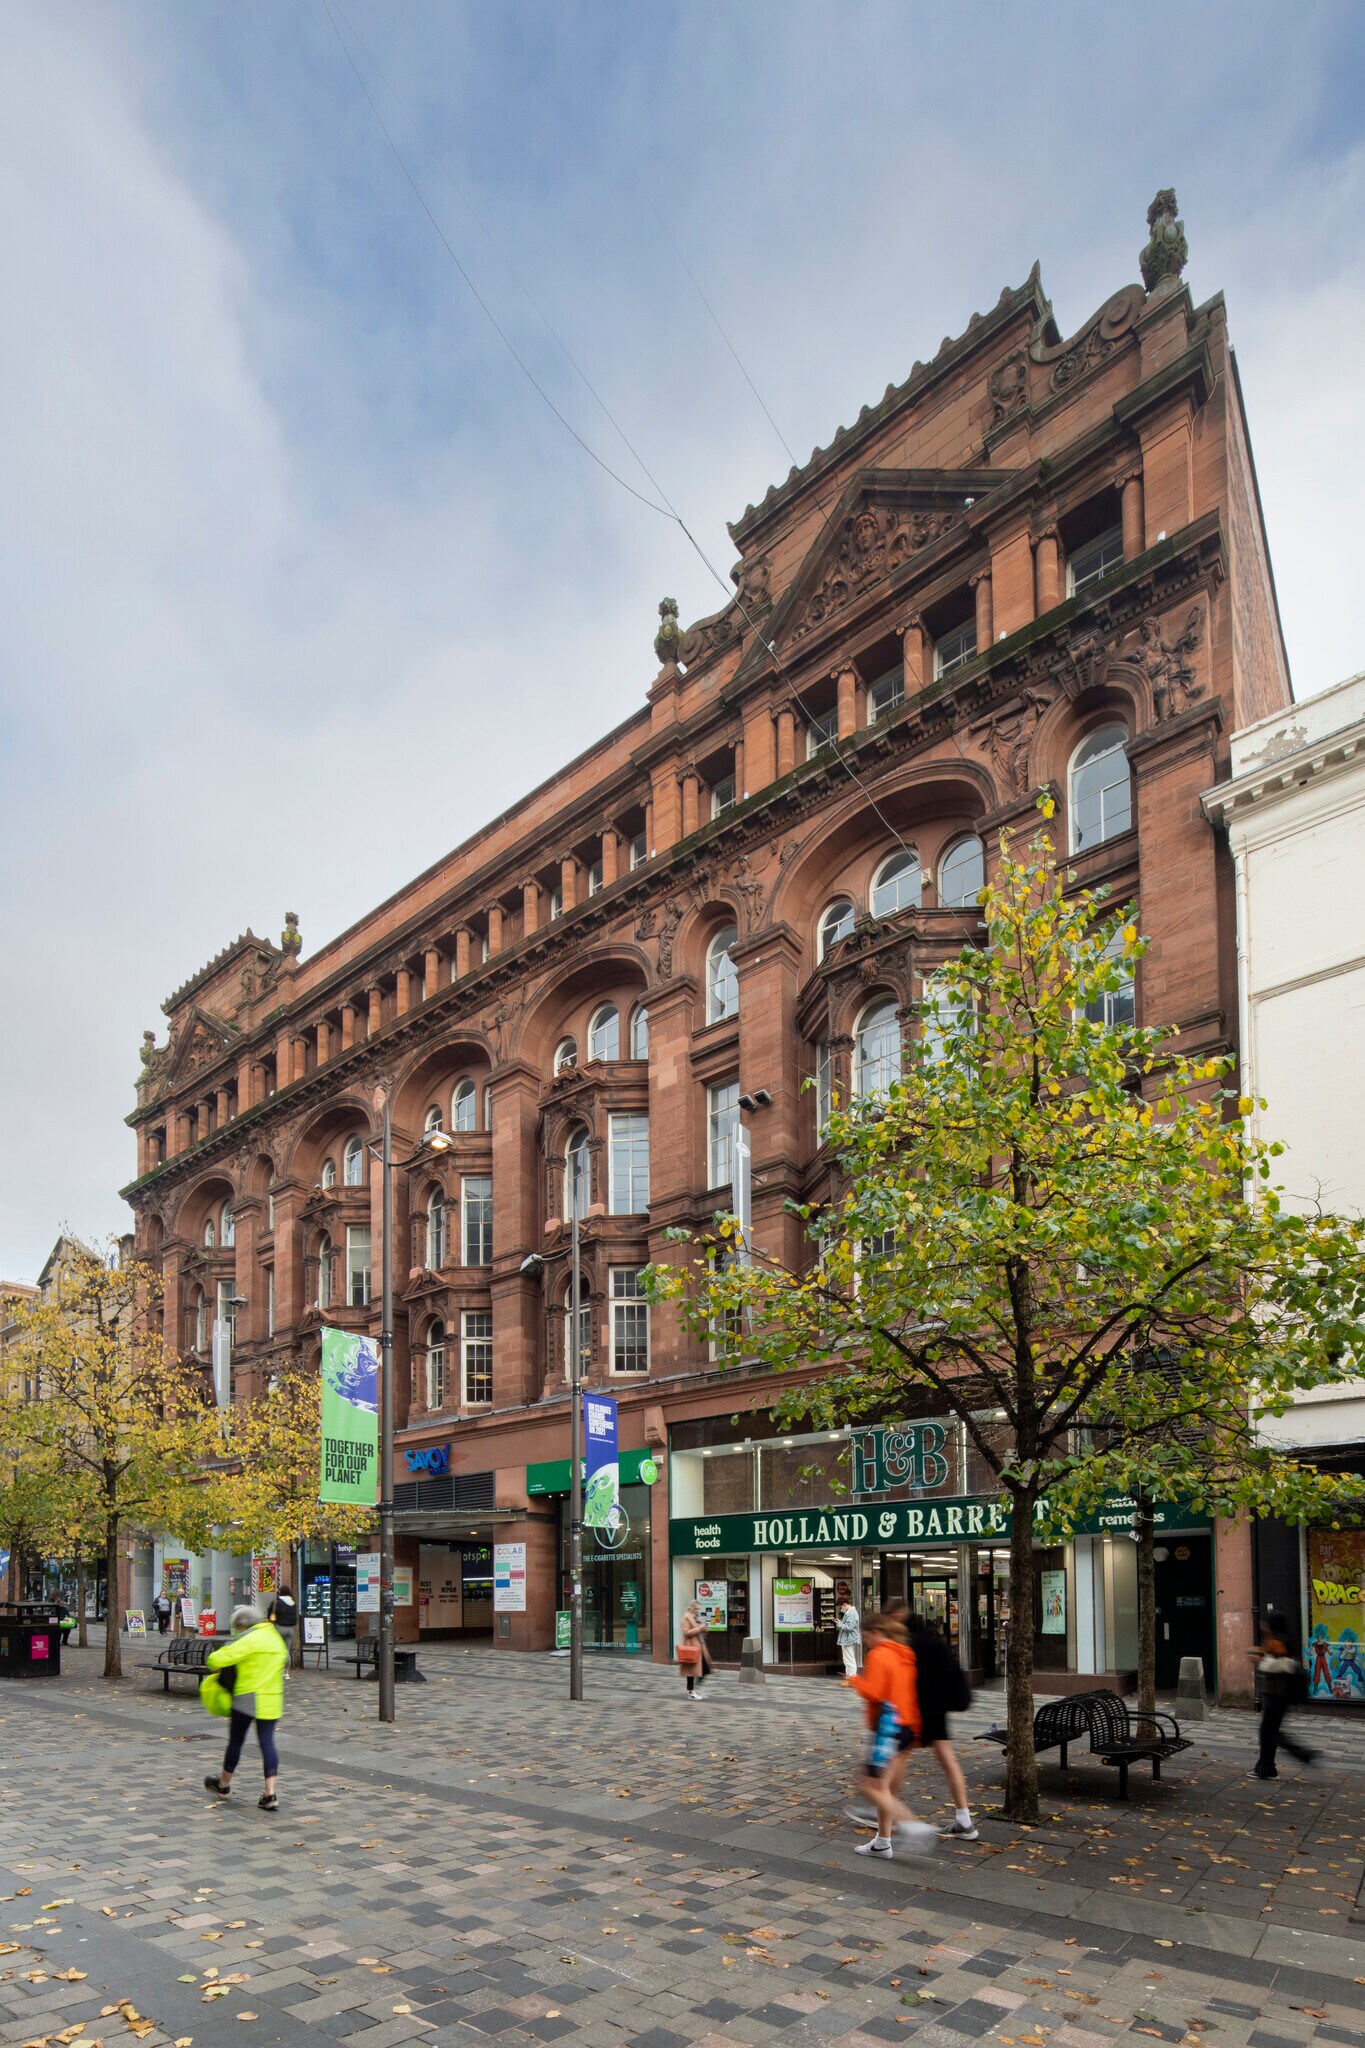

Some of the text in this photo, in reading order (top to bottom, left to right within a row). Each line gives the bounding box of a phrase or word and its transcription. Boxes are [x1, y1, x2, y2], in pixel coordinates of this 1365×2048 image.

[595, 1404, 611, 1415] CLIMATE
[588, 1418, 614, 1430] CONFERENCE
[325, 1438, 374, 1458] TOGETHER
[325, 1453, 367, 1471] FOR OUR
[404, 1443, 451, 1472] SAVOY
[849, 1422, 949, 1495] H&B
[325, 1468, 361, 1485] PLANET
[753, 1500, 1050, 1546] HOLLAND & BARRET
[694, 1524, 721, 1537] health
[695, 1537, 721, 1549] foods
[497, 1547, 523, 1555] COLAB
[591, 1553, 616, 1562] E-CIGARETTE
[616, 1552, 642, 1560] SPECIALISTS
[358, 1556, 379, 1564] COLAB
[776, 1581, 796, 1590] New
